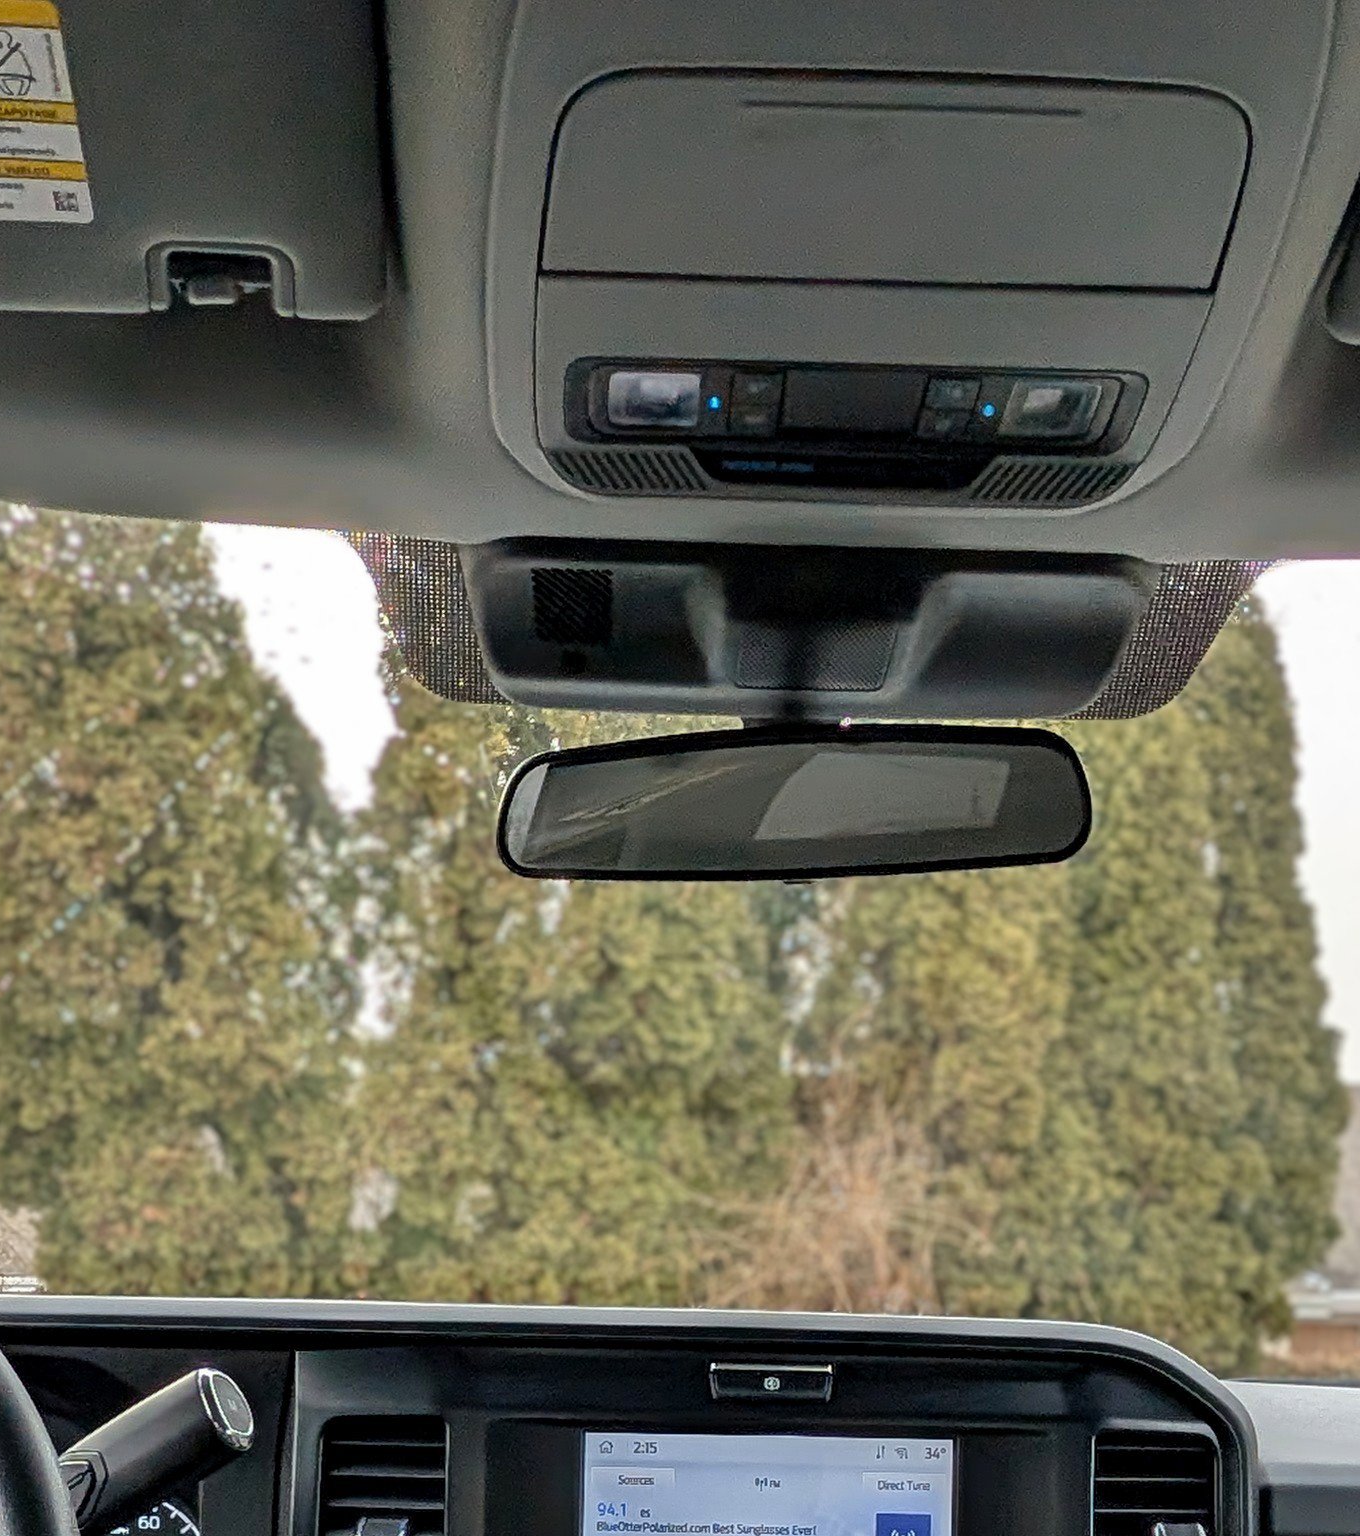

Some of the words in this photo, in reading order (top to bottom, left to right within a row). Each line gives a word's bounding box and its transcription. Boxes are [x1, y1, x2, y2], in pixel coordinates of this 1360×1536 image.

[633, 1441, 658, 1455] 2:15
[618, 1475, 655, 1486] Sources
[877, 1480, 904, 1491] Direct
[906, 1480, 931, 1492] Tune
[597, 1502, 628, 1517] 94.1
[137, 1515, 161, 1530] 60
[712, 1522, 735, 1534] Best
[737, 1524, 790, 1536] Sunglasses
